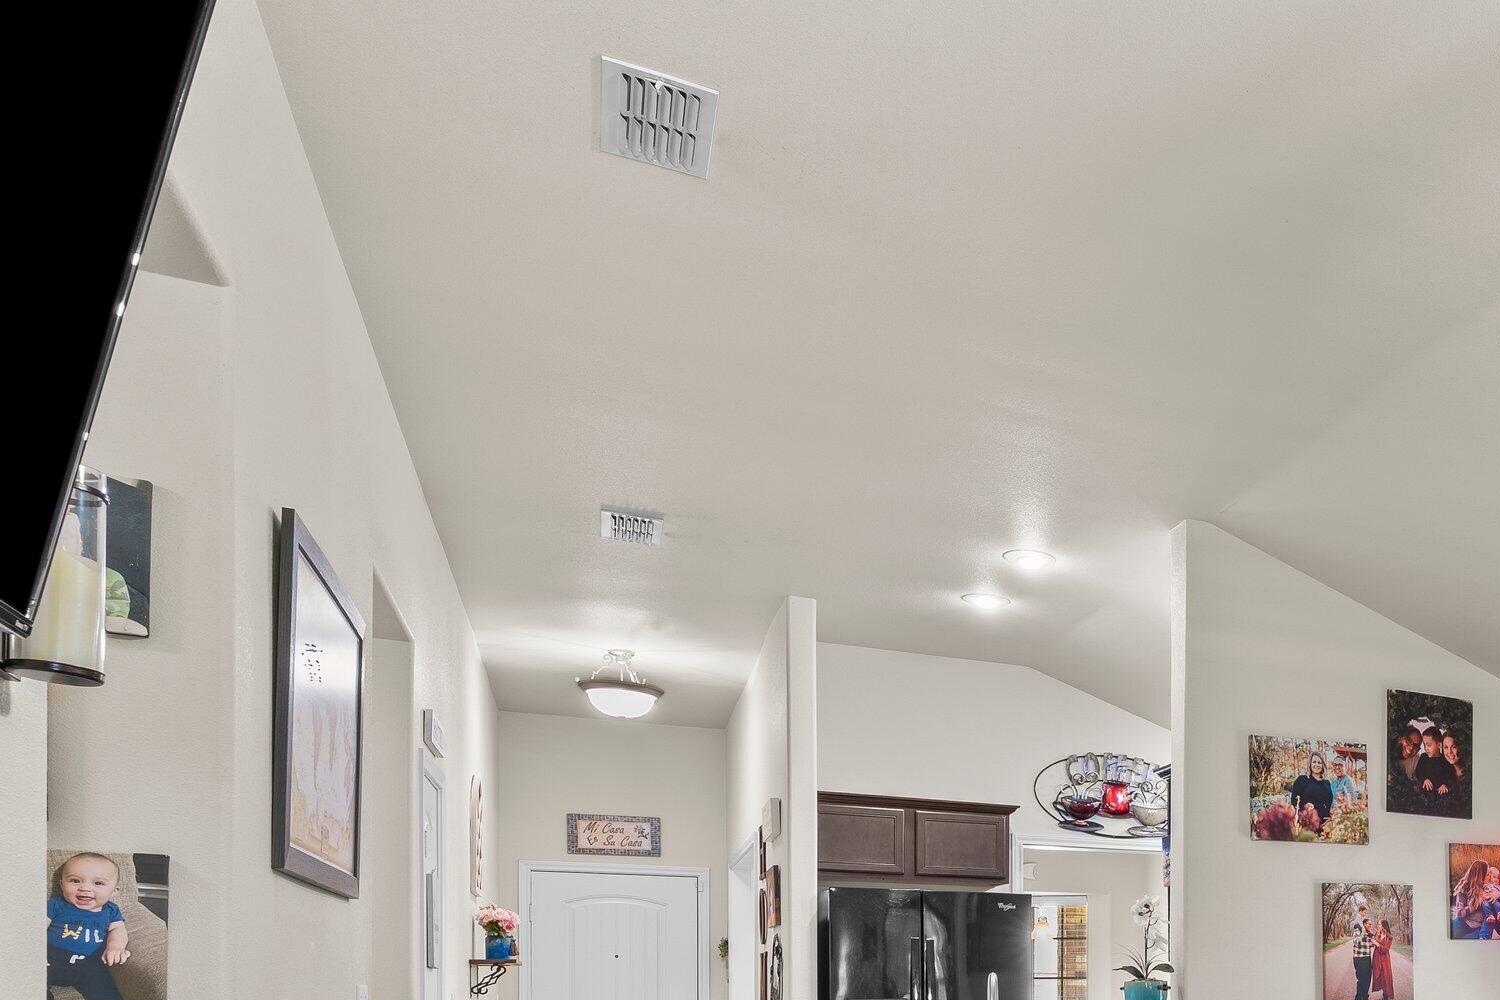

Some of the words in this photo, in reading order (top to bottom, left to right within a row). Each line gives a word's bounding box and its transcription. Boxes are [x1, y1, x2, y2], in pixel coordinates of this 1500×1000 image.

[582, 821, 600, 834] Mi
[601, 822, 625, 834] Casa
[620, 836, 643, 848] Casa
